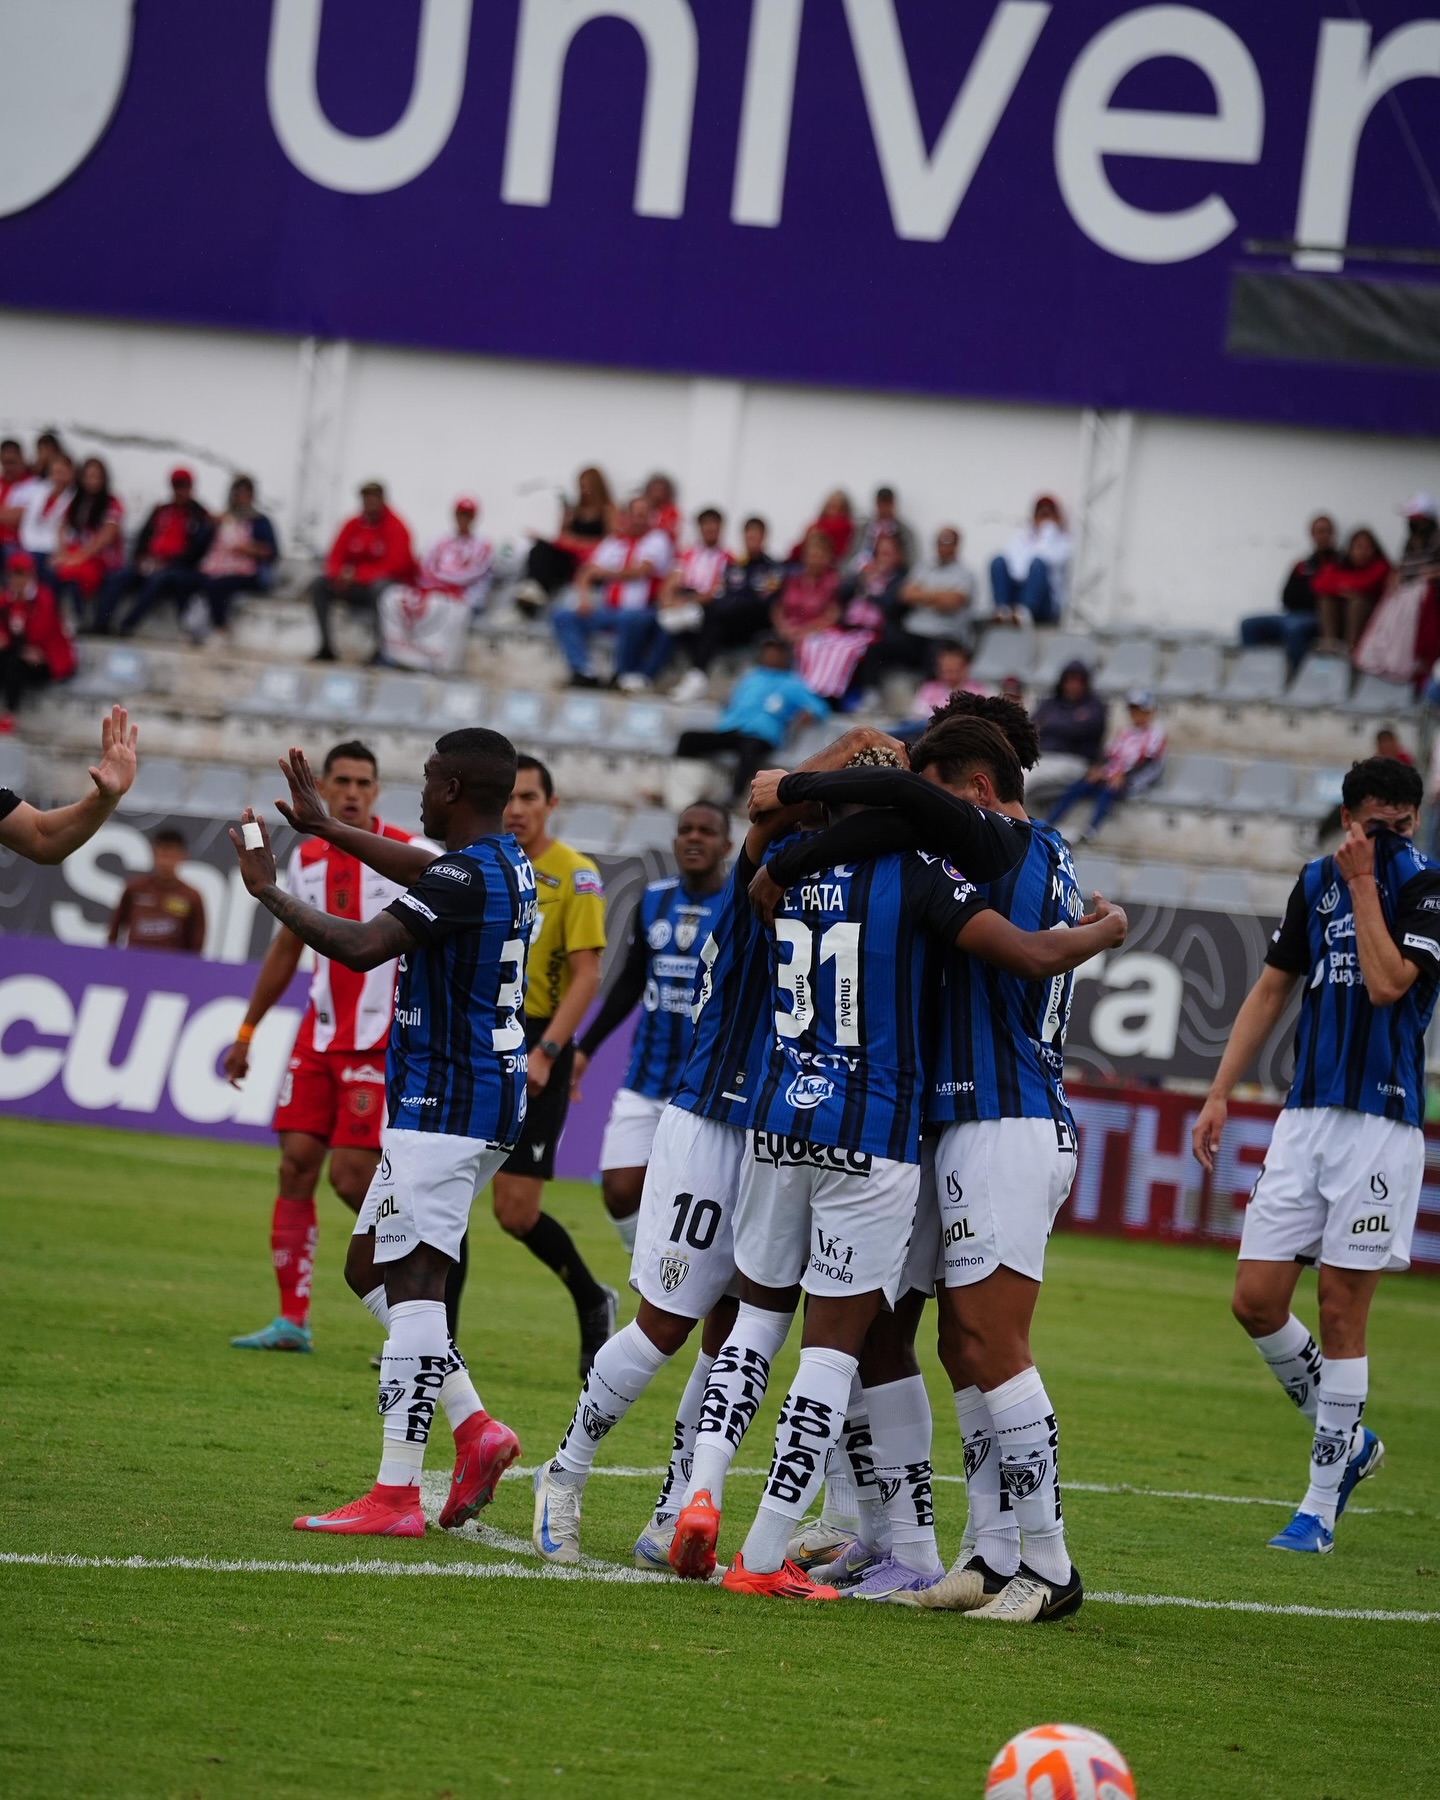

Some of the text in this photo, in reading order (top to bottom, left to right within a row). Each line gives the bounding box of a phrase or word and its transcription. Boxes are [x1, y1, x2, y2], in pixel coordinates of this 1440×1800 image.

[429, 865, 468, 882] PILSENER
[784, 884, 844, 912] E. PATA
[775, 918, 862, 1047] 31
[795, 974, 805, 1013] venus
[841, 978, 850, 1020] venus
[776, 1037, 860, 1072] RECTV
[936, 1081, 975, 1093] LATIDOS
[669, 1192, 722, 1250] 10
[945, 1218, 975, 1248] GOL
[1352, 1215, 1390, 1235] GOL
[817, 1228, 853, 1265] Vivi
[811, 1254, 854, 1284] Canola
[405, 1356, 448, 1444] ROLAND
[768, 1395, 833, 1504] ROLAND
